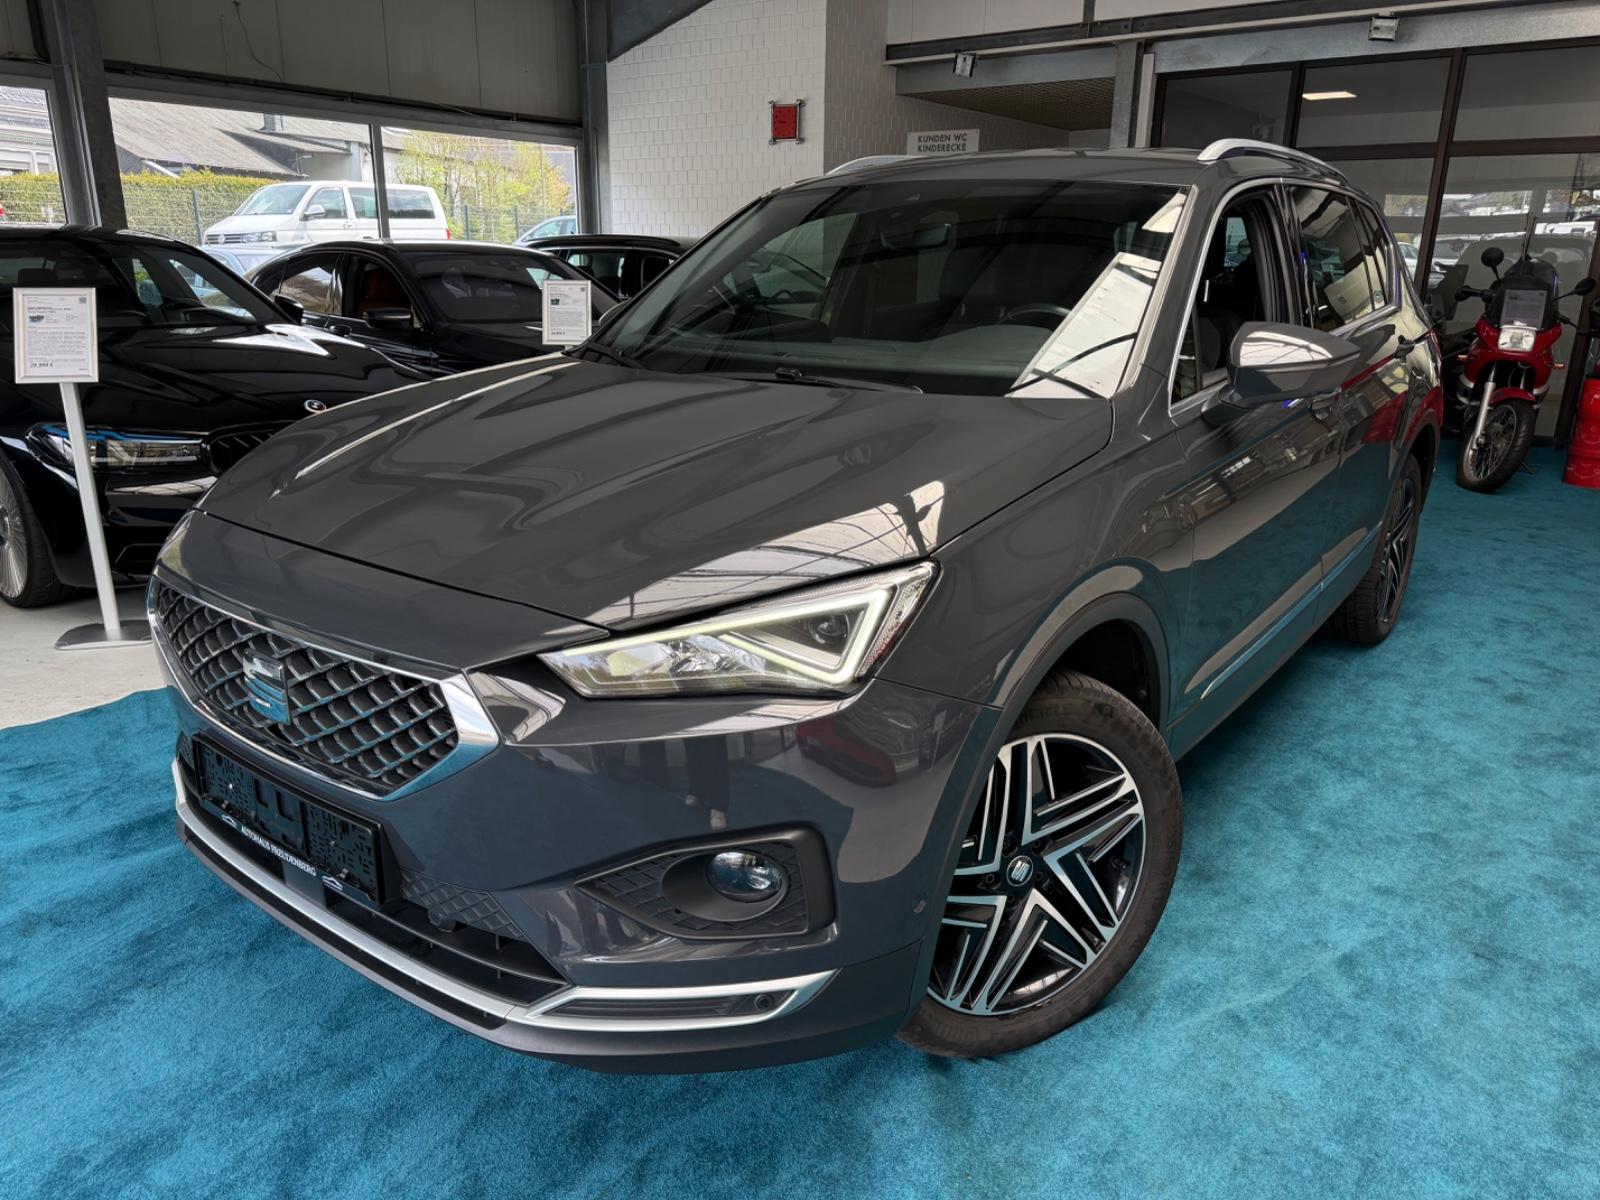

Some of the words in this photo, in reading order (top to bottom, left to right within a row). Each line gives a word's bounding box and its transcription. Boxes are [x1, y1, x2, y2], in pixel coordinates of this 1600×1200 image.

[918, 134, 950, 142] KUNDEN
[954, 133, 967, 141] WC
[918, 143, 966, 152] KINDERECKE
[241, 825, 271, 851] AUTOHAUS
[270, 843, 317, 876] FREUDENBERG
